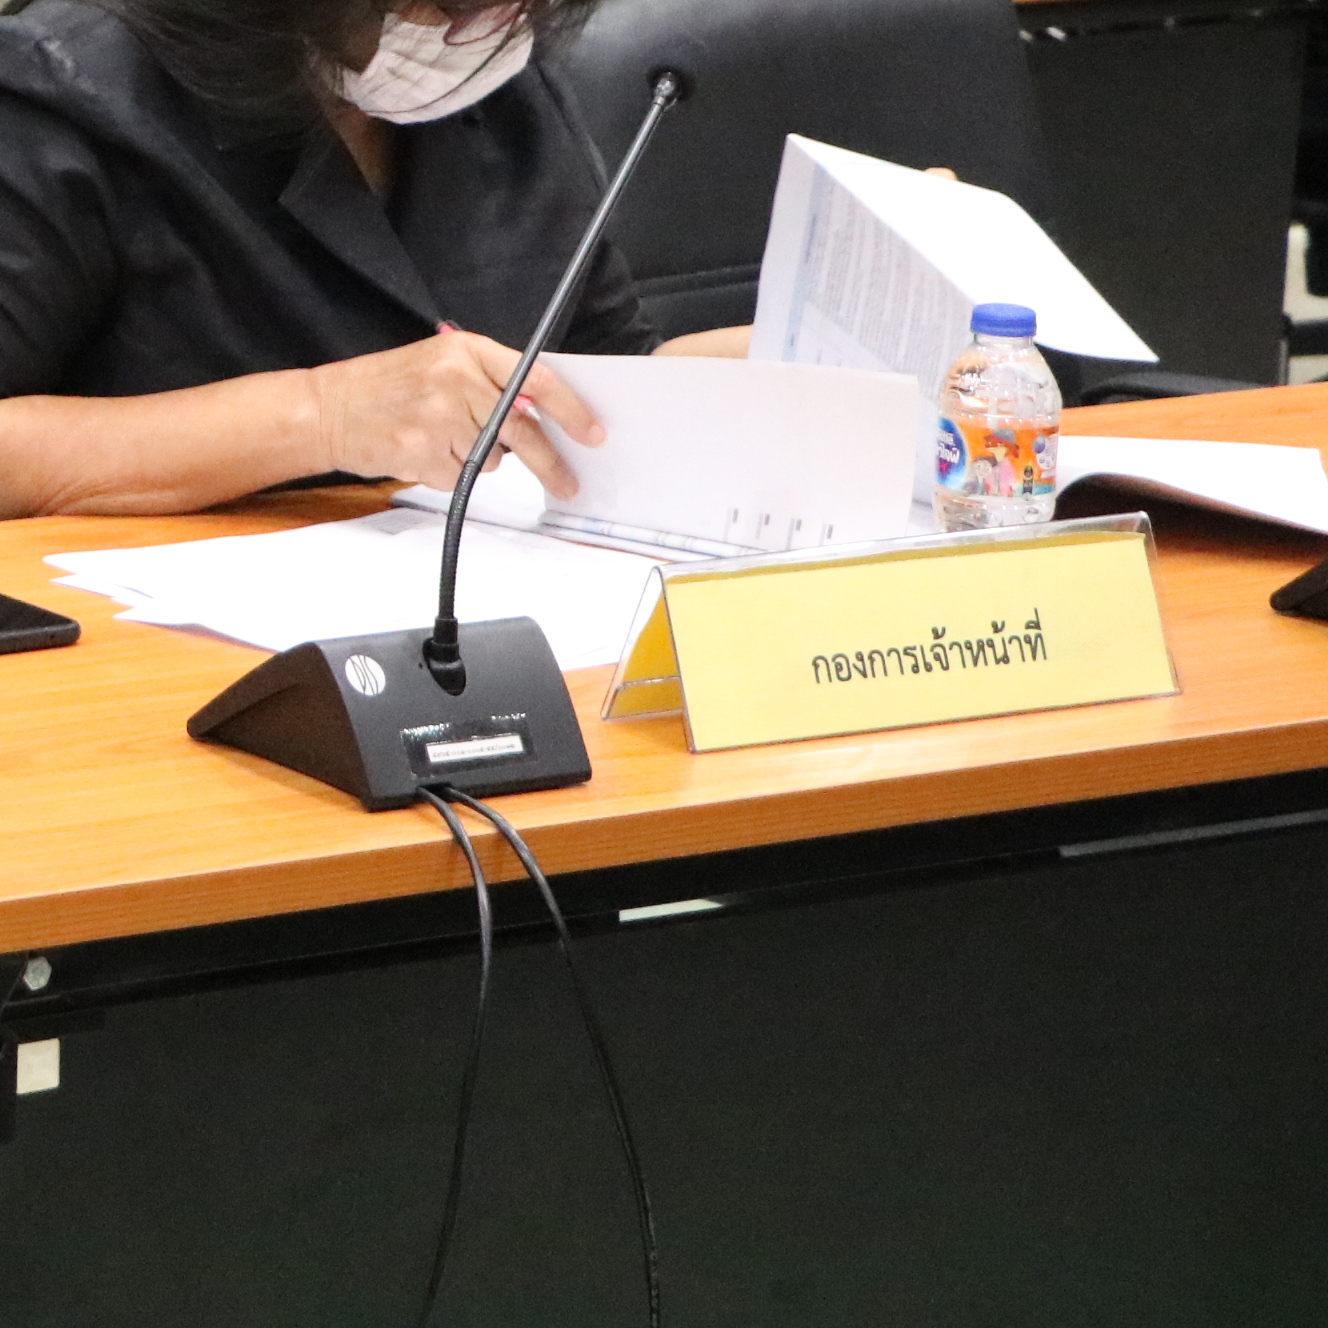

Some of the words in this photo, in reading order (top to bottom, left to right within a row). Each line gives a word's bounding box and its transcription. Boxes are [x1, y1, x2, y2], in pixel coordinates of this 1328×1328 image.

[811, 607, 1047, 684] กองการเจ้าหน้าที่
